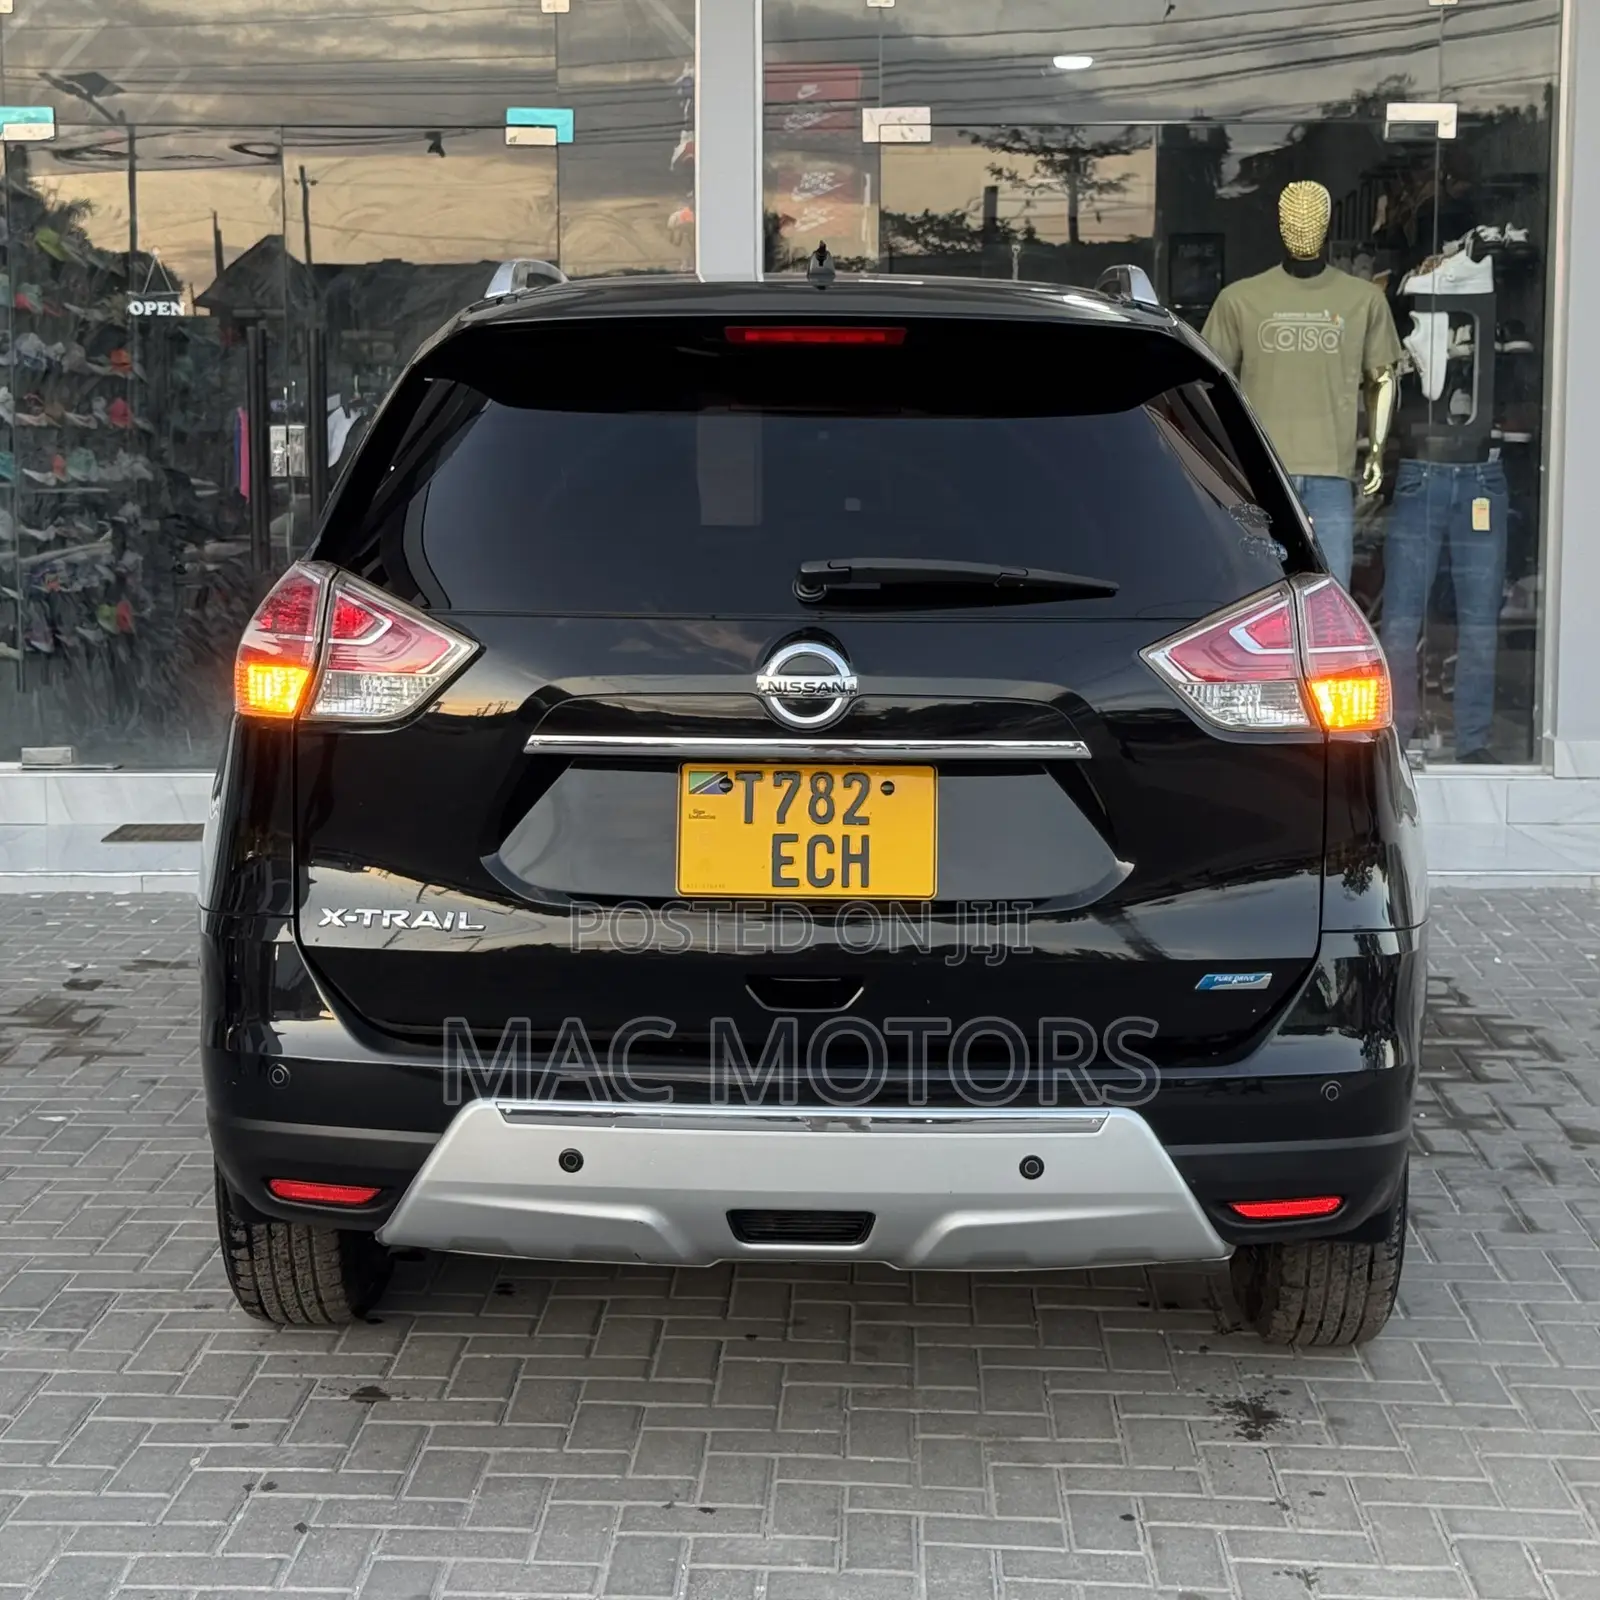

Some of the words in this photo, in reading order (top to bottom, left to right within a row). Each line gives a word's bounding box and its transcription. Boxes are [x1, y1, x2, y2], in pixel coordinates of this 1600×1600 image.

[129, 300, 186, 316] OPEN
[767, 681, 846, 693] NISSAN
[735, 770, 871, 825] T782
[771, 833, 870, 888] ECH
[317, 908, 487, 932] X-TRAIL
